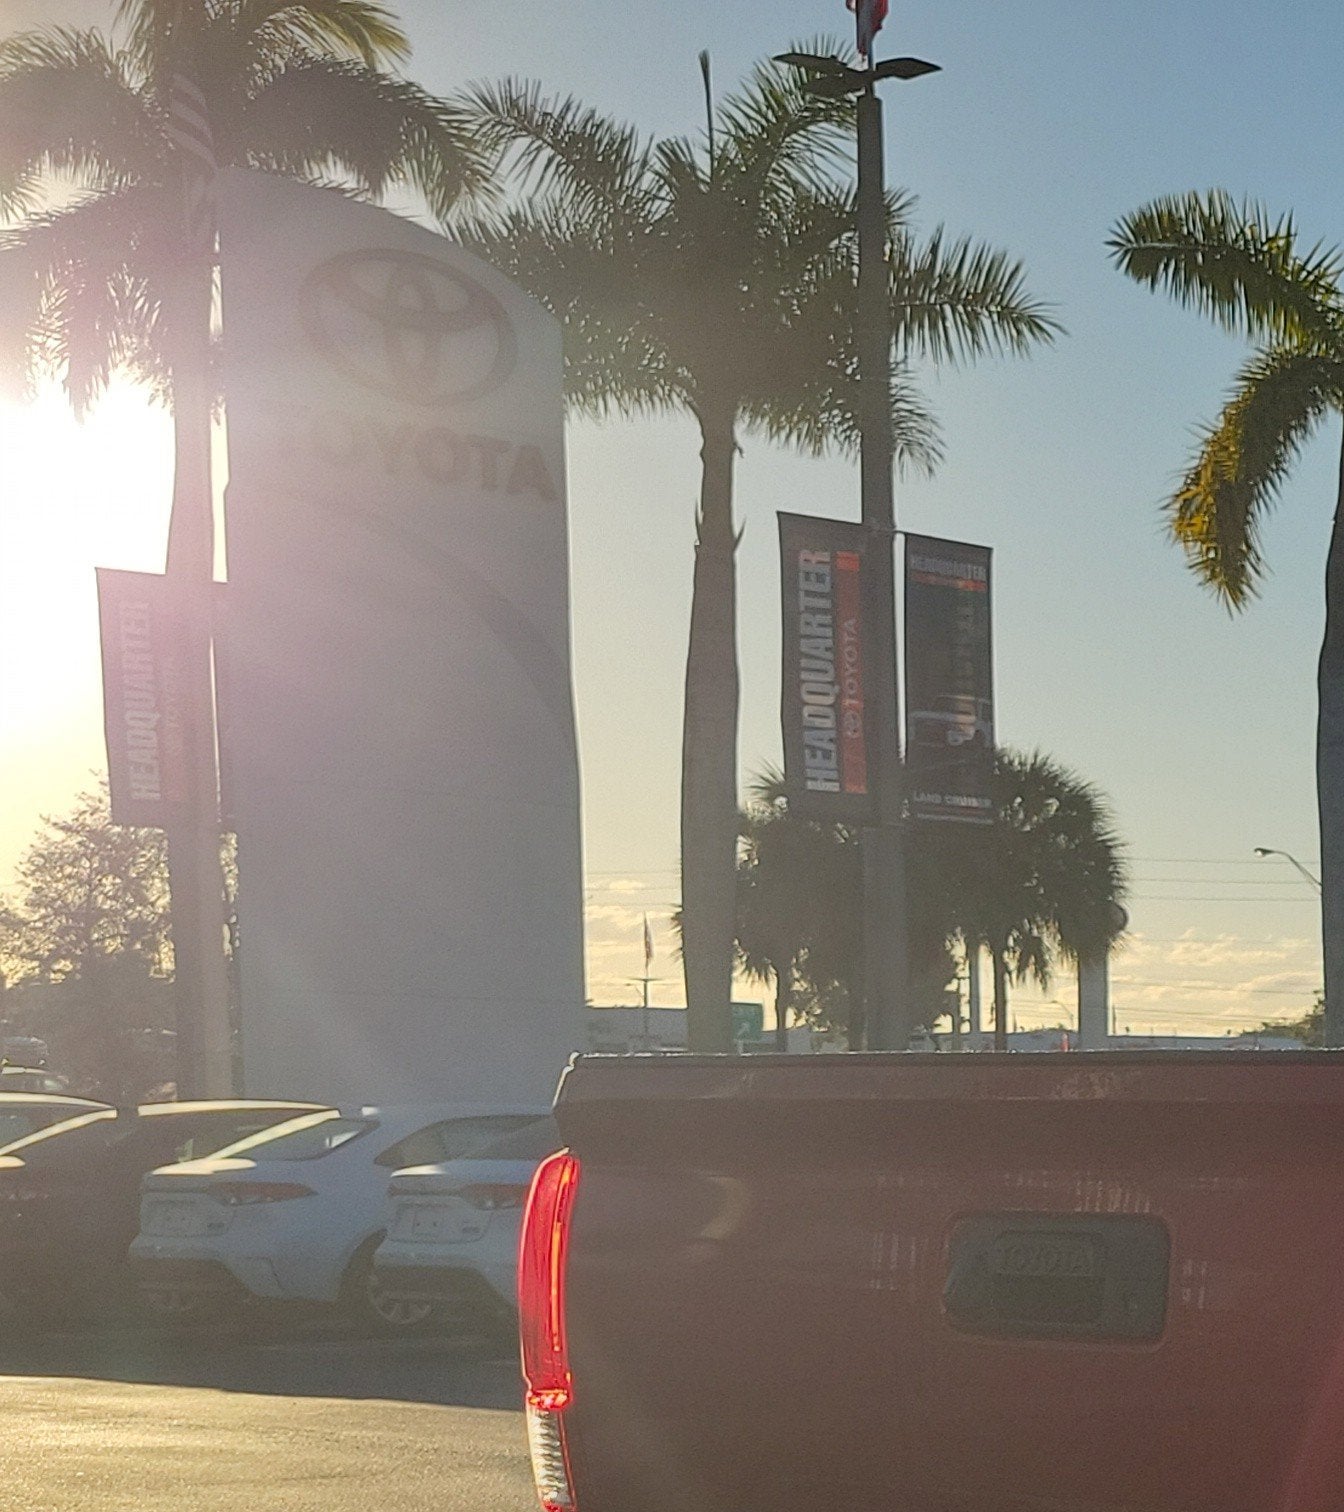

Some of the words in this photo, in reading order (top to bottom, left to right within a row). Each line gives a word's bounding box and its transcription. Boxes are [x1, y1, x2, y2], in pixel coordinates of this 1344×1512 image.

[119, 601, 162, 801] HEADQUARTER
[798, 549, 841, 793] HEADQUARTER
[843, 617, 862, 706] TOYOTA
